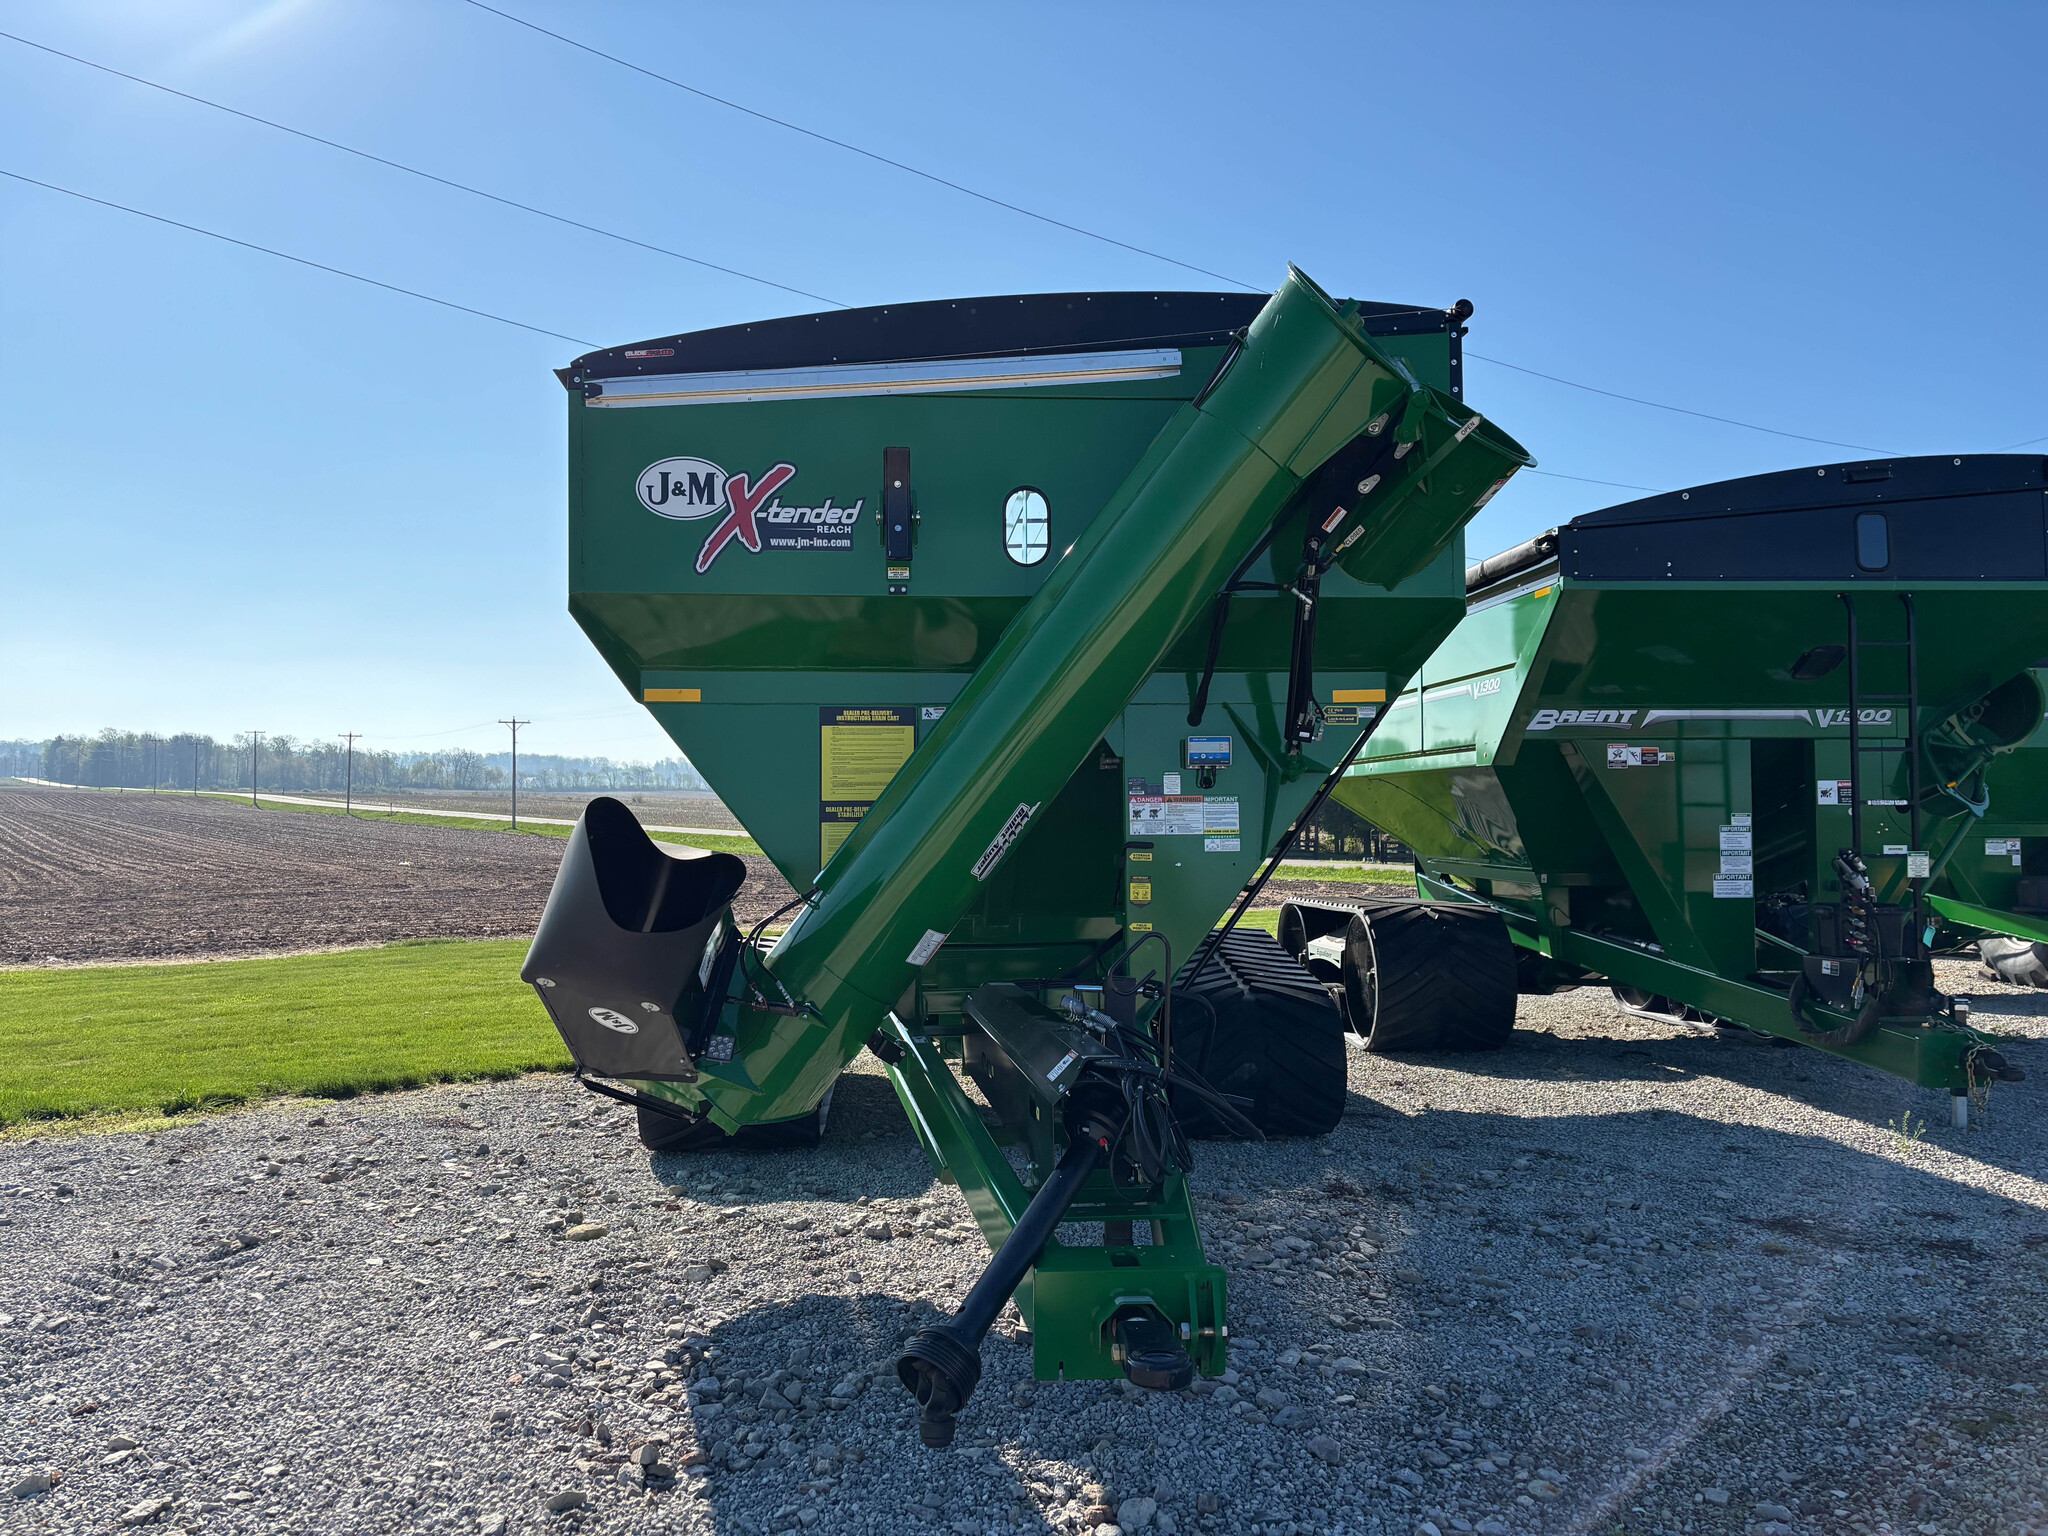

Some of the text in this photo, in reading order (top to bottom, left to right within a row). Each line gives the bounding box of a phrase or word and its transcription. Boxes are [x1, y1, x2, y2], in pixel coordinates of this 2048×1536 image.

[1461, 421, 1476, 435] OPEN
[646, 472, 716, 506] J&M
[817, 526, 852, 534] REACH
[1345, 528, 1362, 546] CLOSED
[770, 538, 850, 548] www.jm-inc.com
[1473, 677, 1500, 700] V1300
[1526, 710, 1638, 730] BRENT
[976, 808, 1025, 872] Bullet Auger
